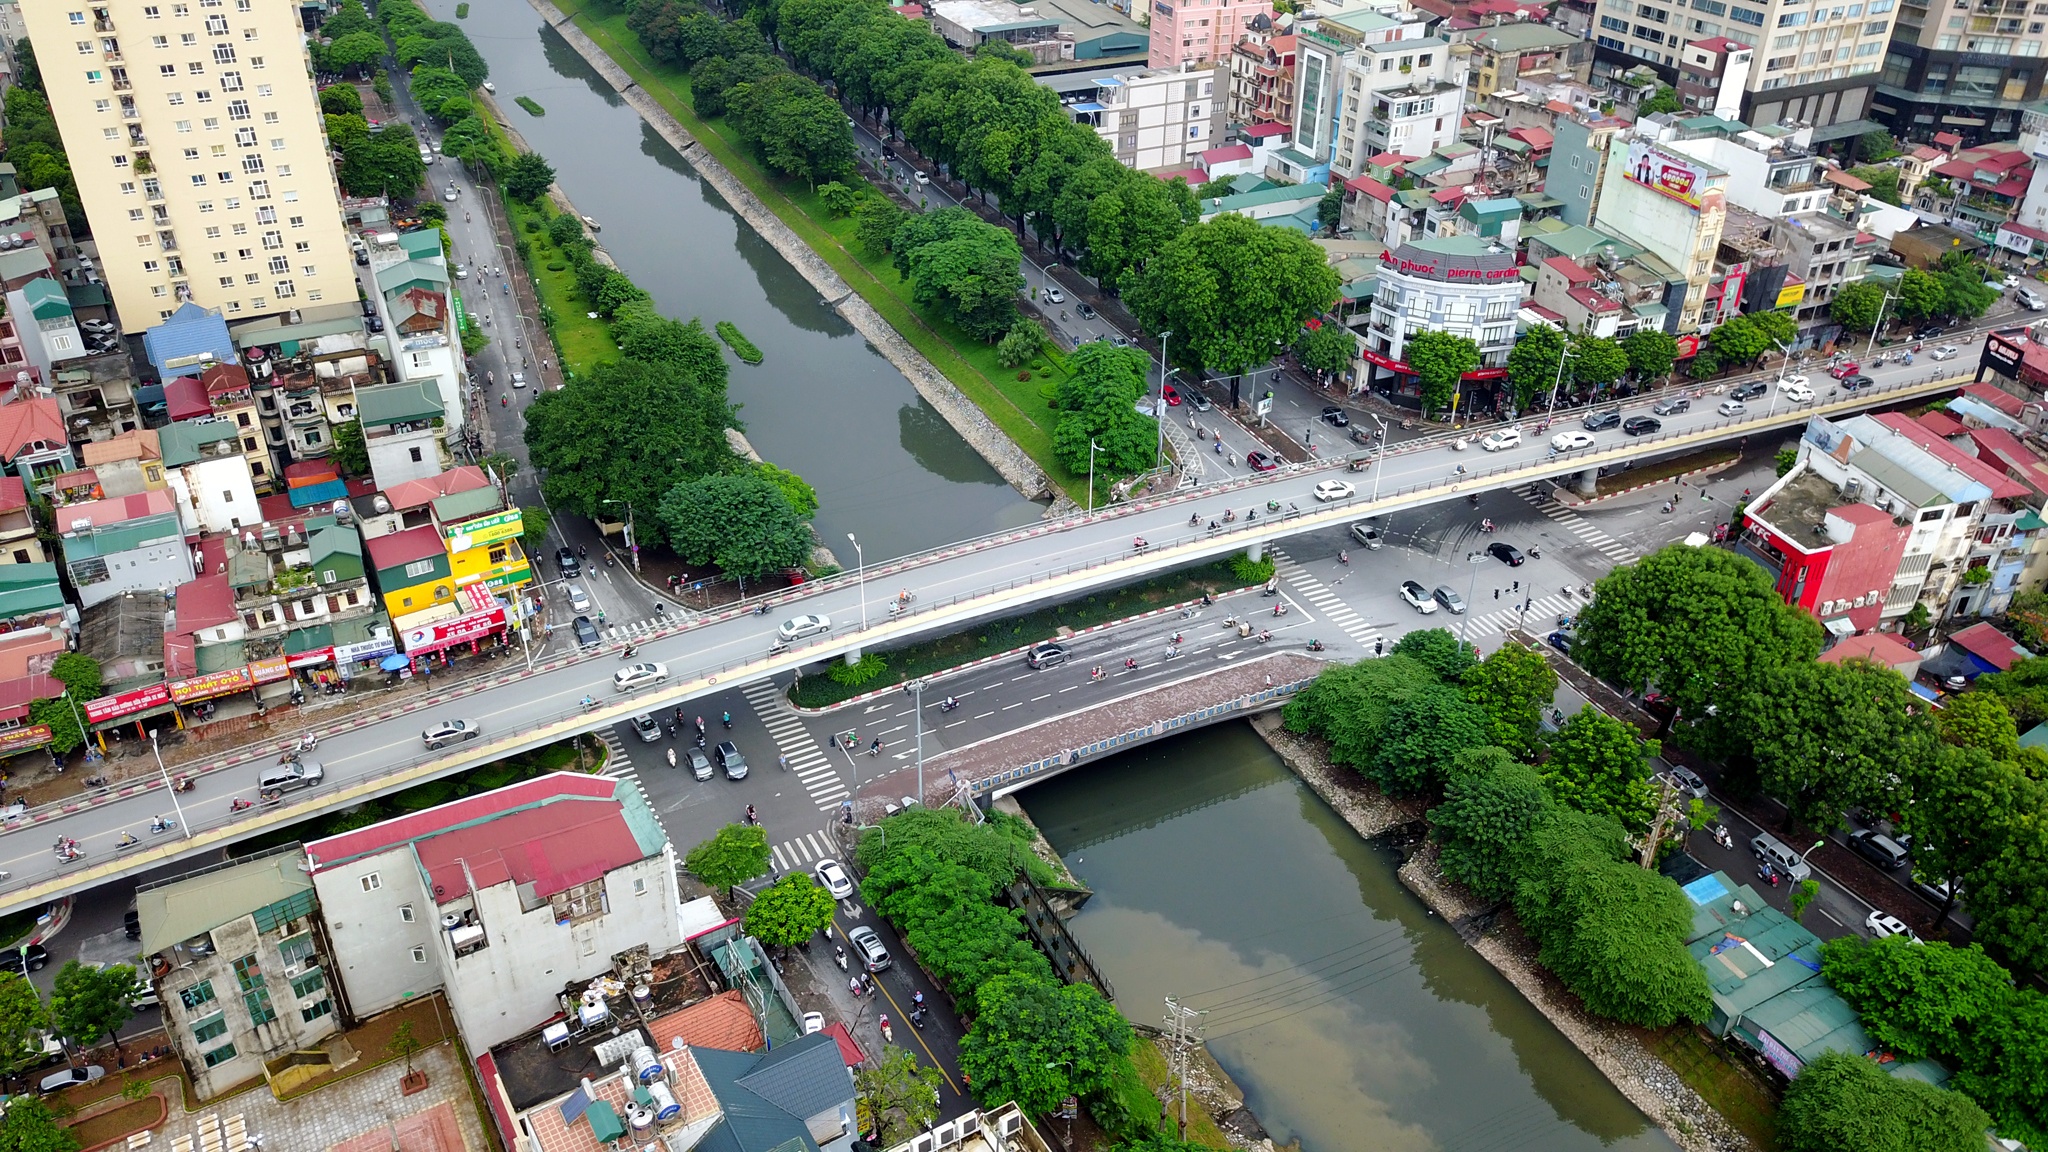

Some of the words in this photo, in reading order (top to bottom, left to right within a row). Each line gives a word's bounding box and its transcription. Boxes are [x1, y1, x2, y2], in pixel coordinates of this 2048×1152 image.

[1447, 267, 1482, 278] pierre
[1486, 267, 1520, 279] cardin
[1748, 521, 1771, 541] KFC
[253, 668, 274, 677] QUẢNG
[275, 663, 287, 672] CÁO
[195, 680, 217, 691] THẤT
